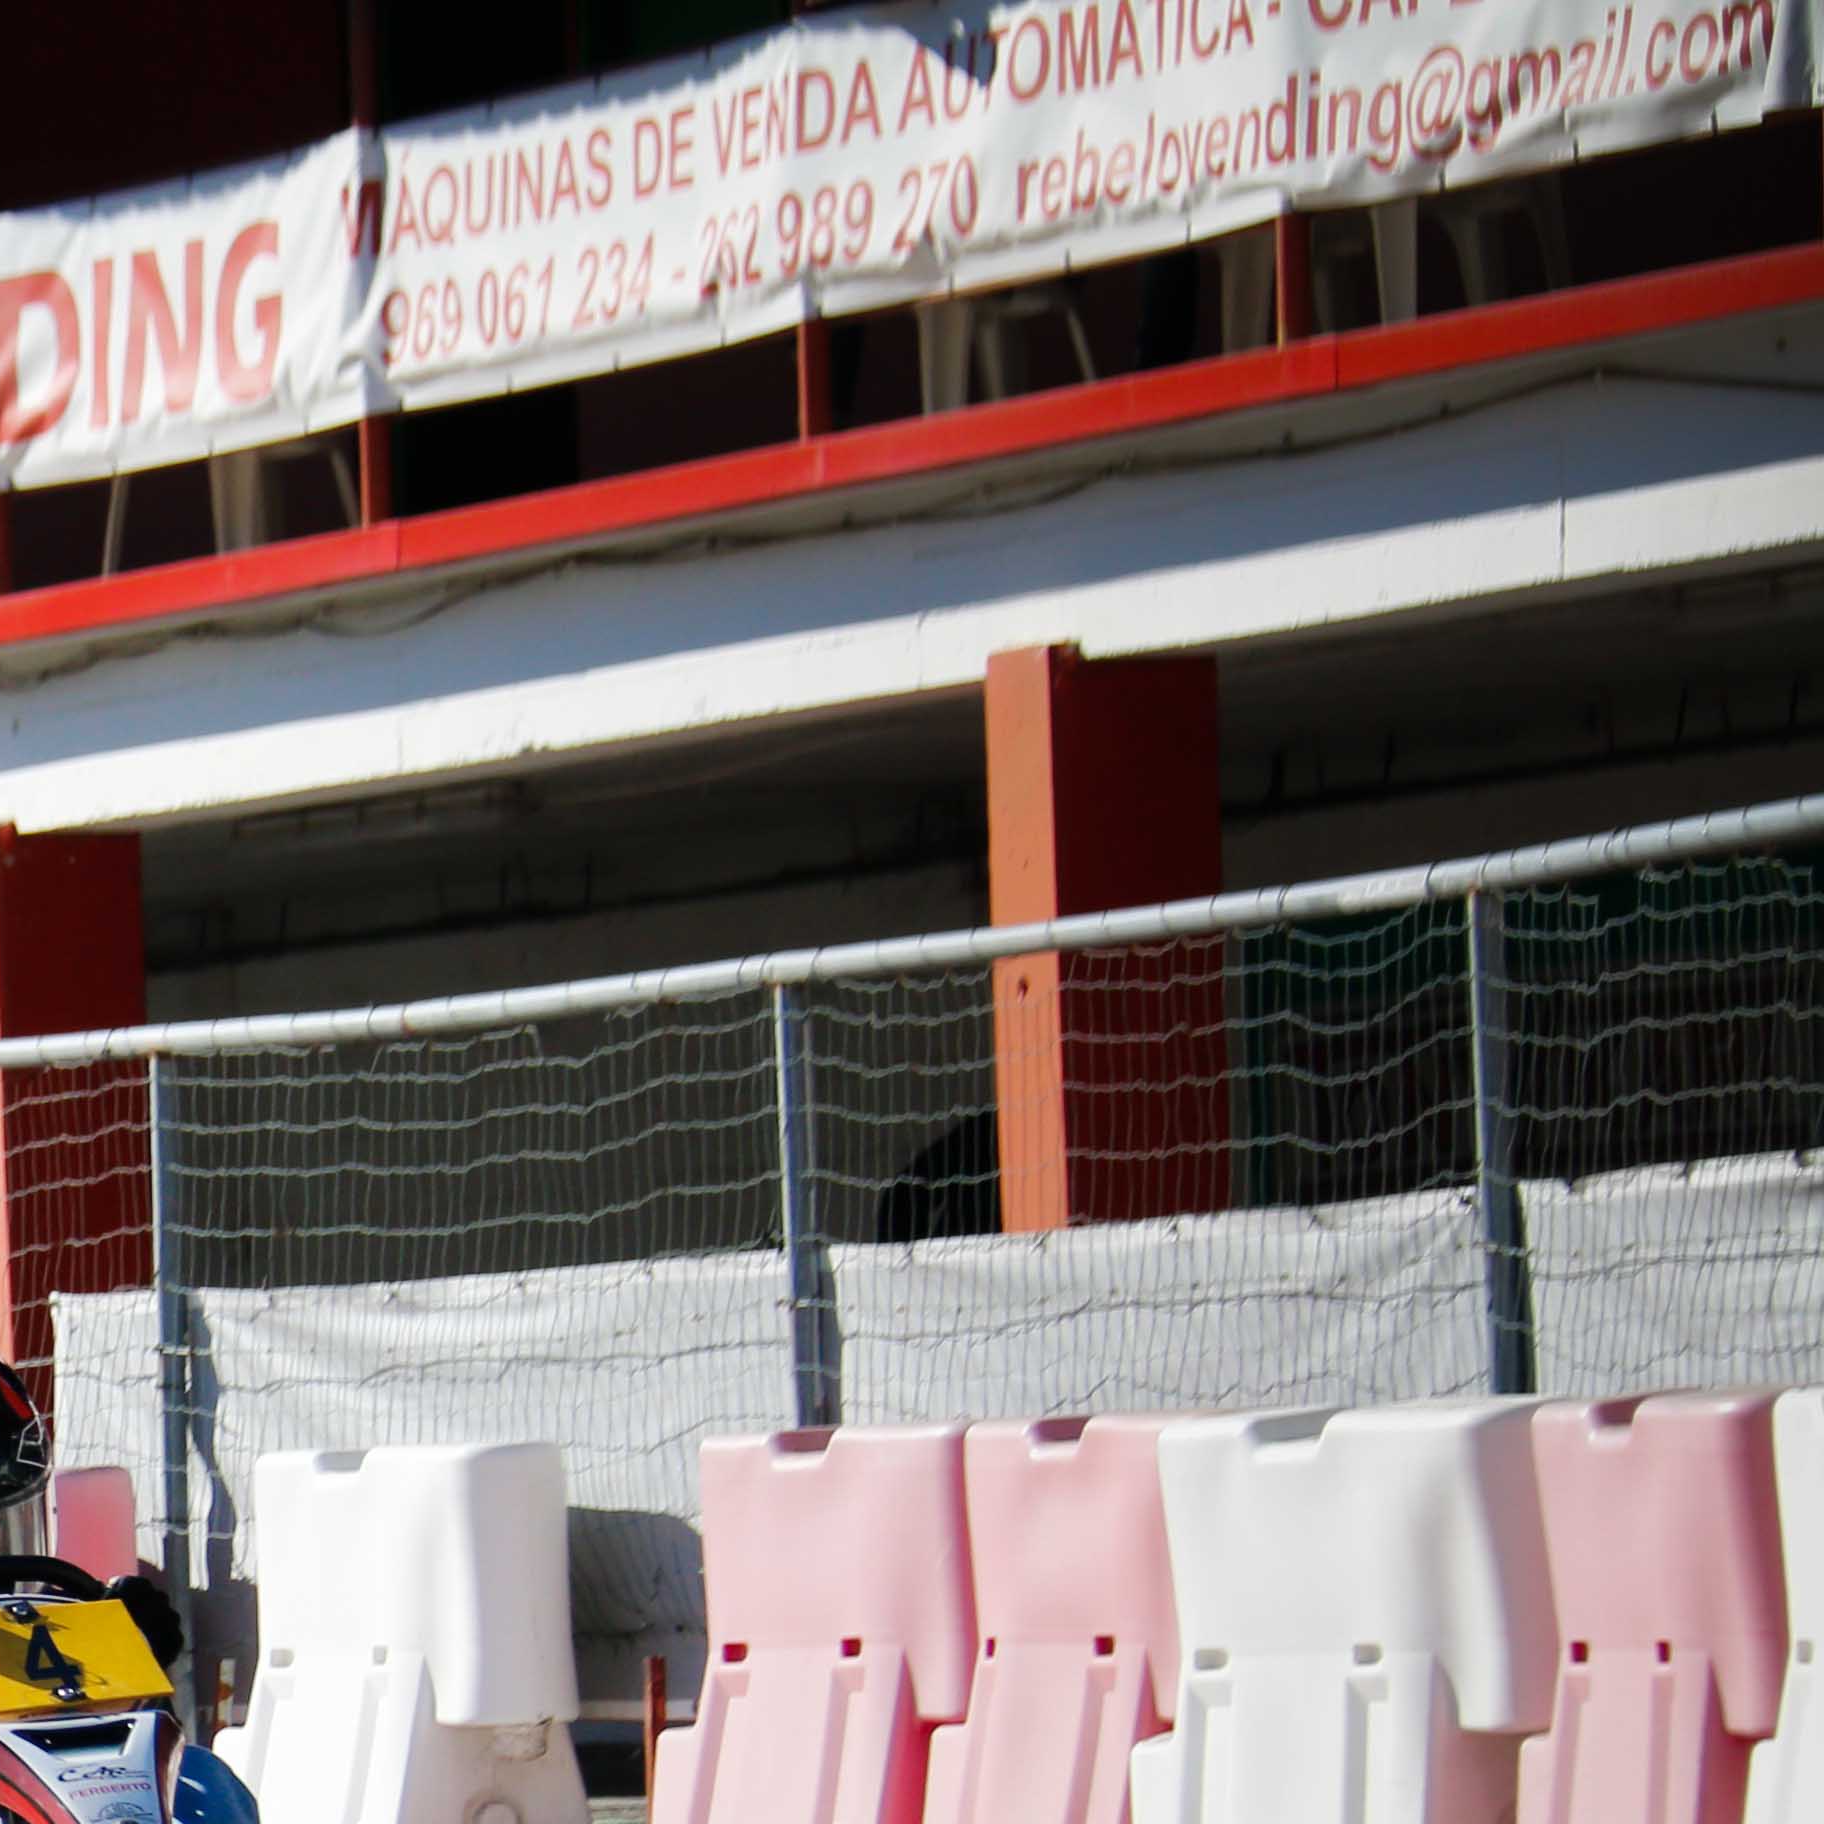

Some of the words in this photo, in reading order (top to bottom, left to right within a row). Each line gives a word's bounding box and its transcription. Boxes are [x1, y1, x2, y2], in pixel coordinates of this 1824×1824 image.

[341, 127, 613, 258] MÁQUINAS
[635, 104, 695, 199] DE
[712, 58, 883, 178] VENDA
[381, 277, 463, 366] 969
[477, 254, 556, 347] 061
[571, 231, 655, 328] 234
[699, 203, 763, 299] 262
[775, 179, 876, 280] 989
[892, 153, 980, 256] 270
[1016, 0, 1774, 224] rebelovending@gmail.com
[25, 1620, 84, 1692] 4
